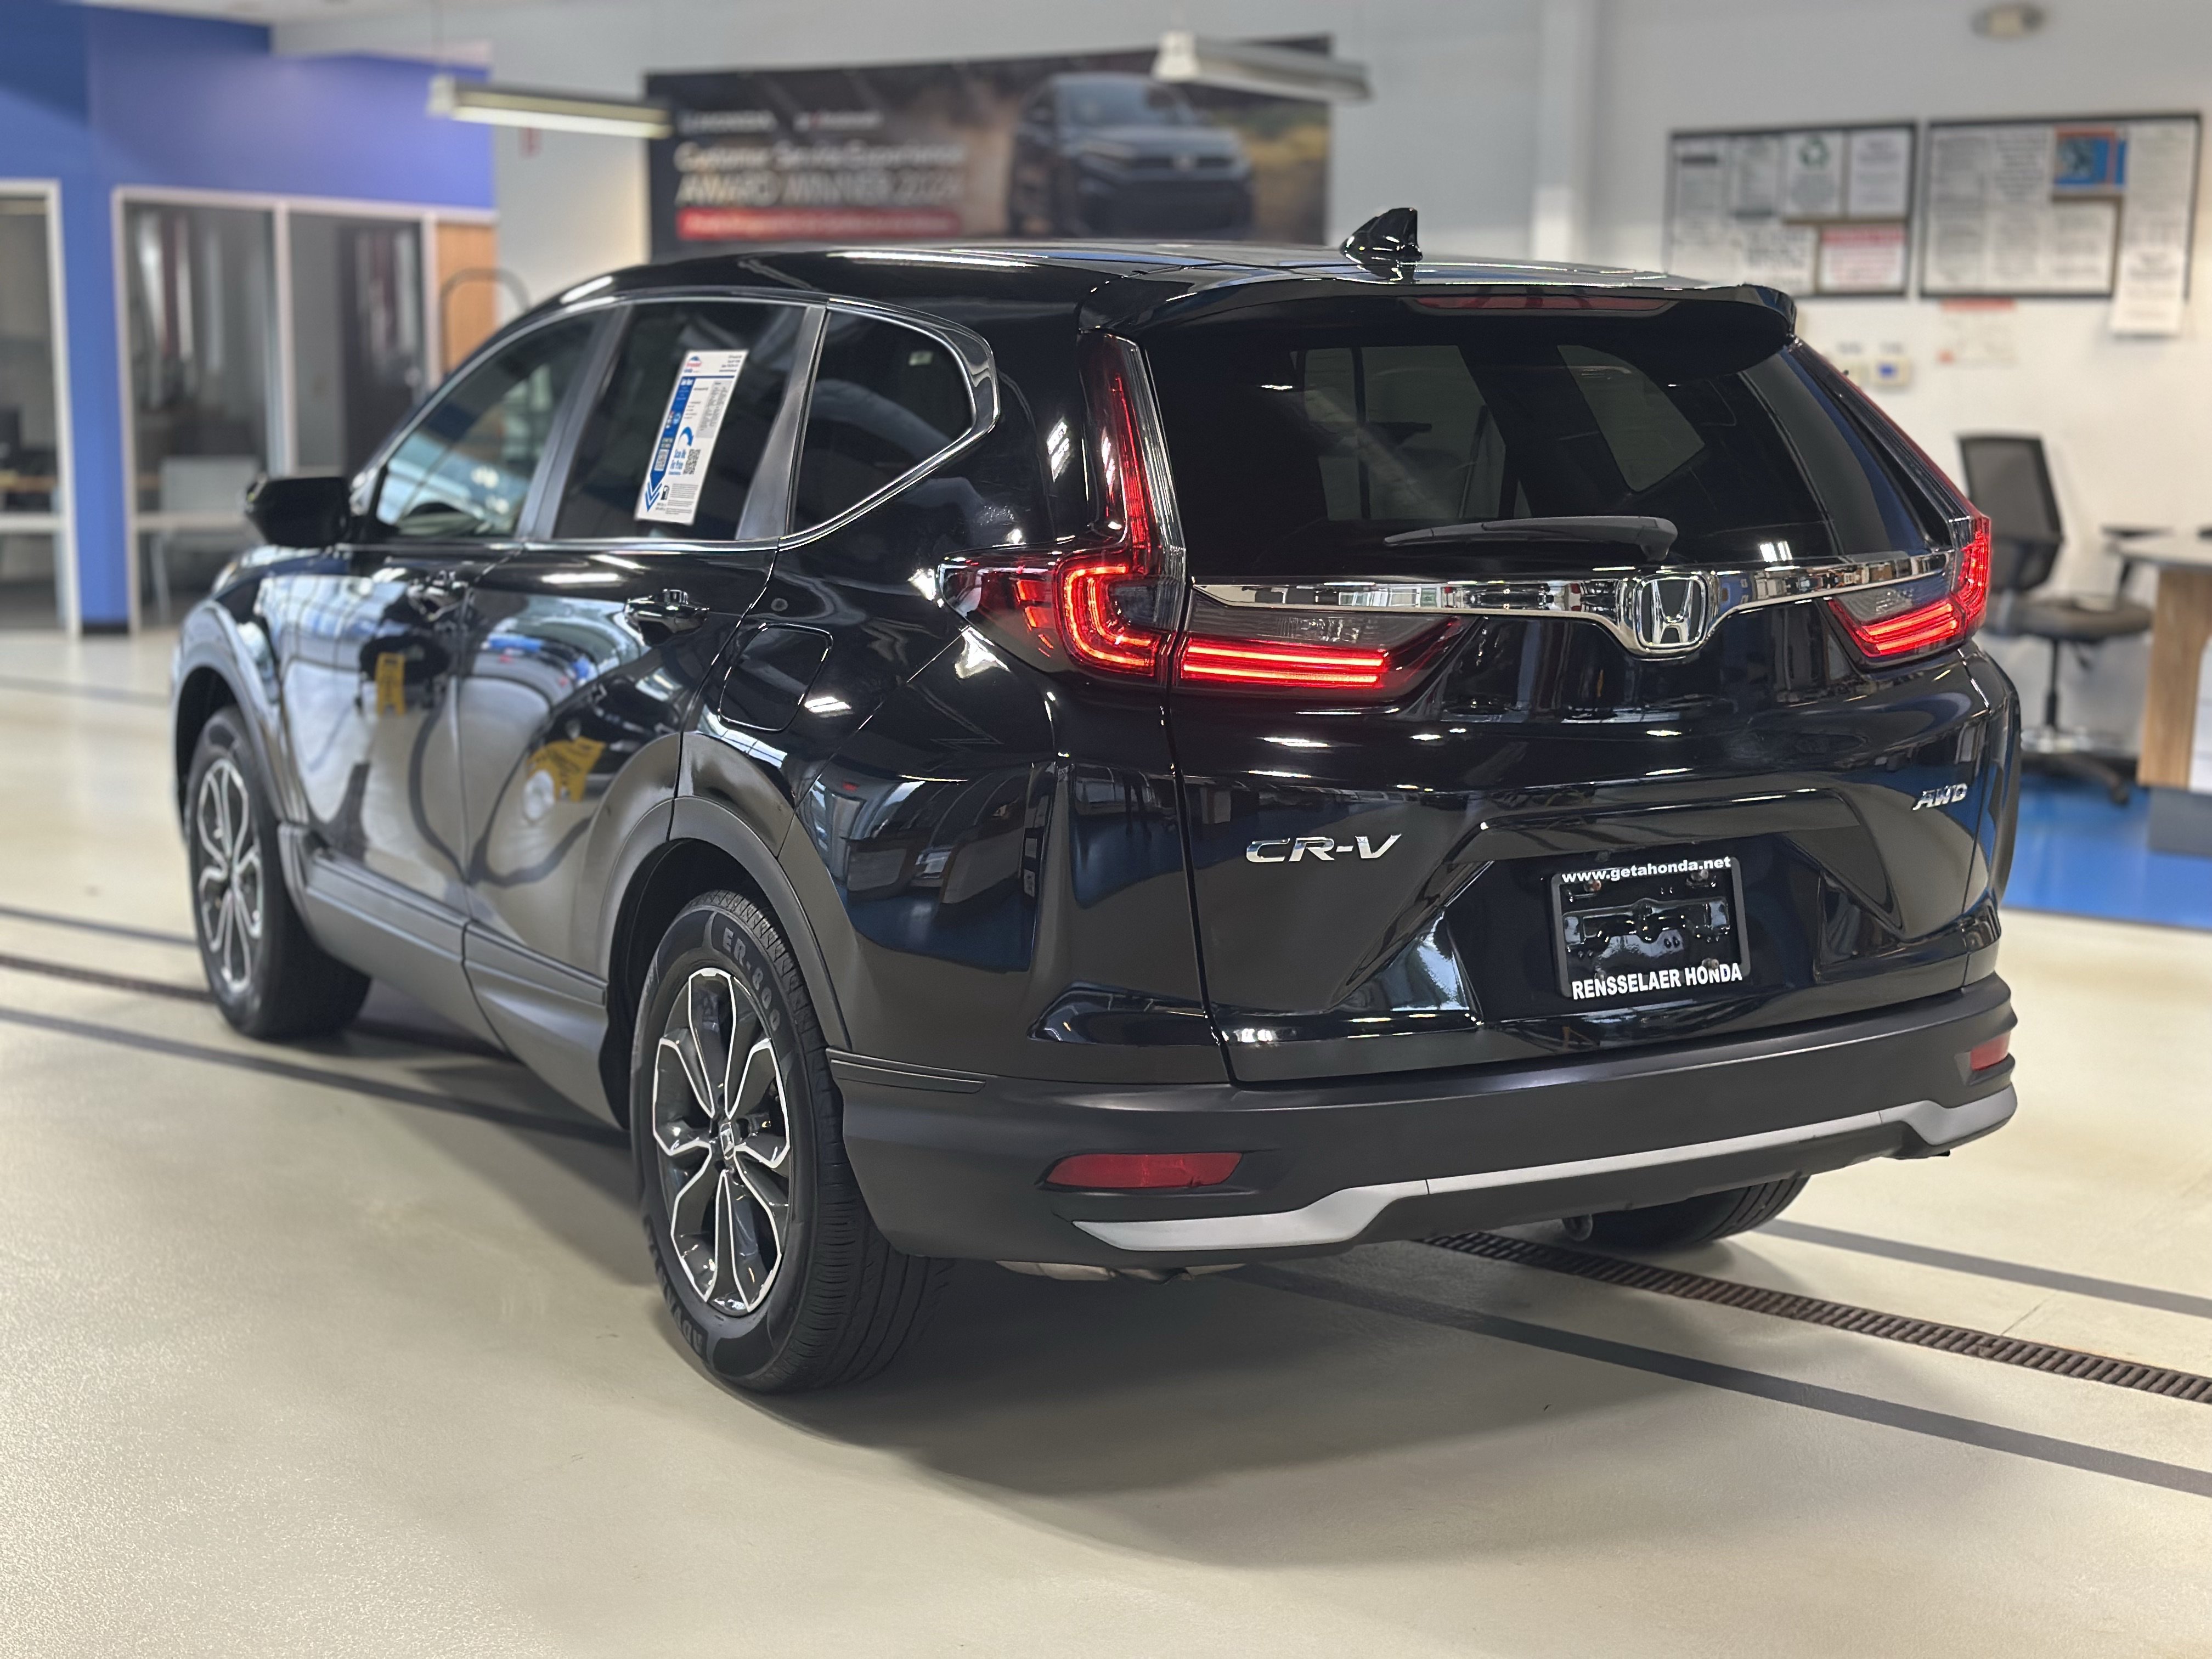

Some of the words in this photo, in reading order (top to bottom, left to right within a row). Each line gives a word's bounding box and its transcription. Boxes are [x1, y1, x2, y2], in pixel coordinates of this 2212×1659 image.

[675, 171, 781, 206] AWARD
[1912, 783, 1968, 810] AWD
[1246, 833, 1402, 863] CR-V
[1562, 856, 1731, 883] www.getahonda.net
[1572, 968, 1680, 1000] RENSSELAER
[1685, 963, 1742, 986] HONDA
